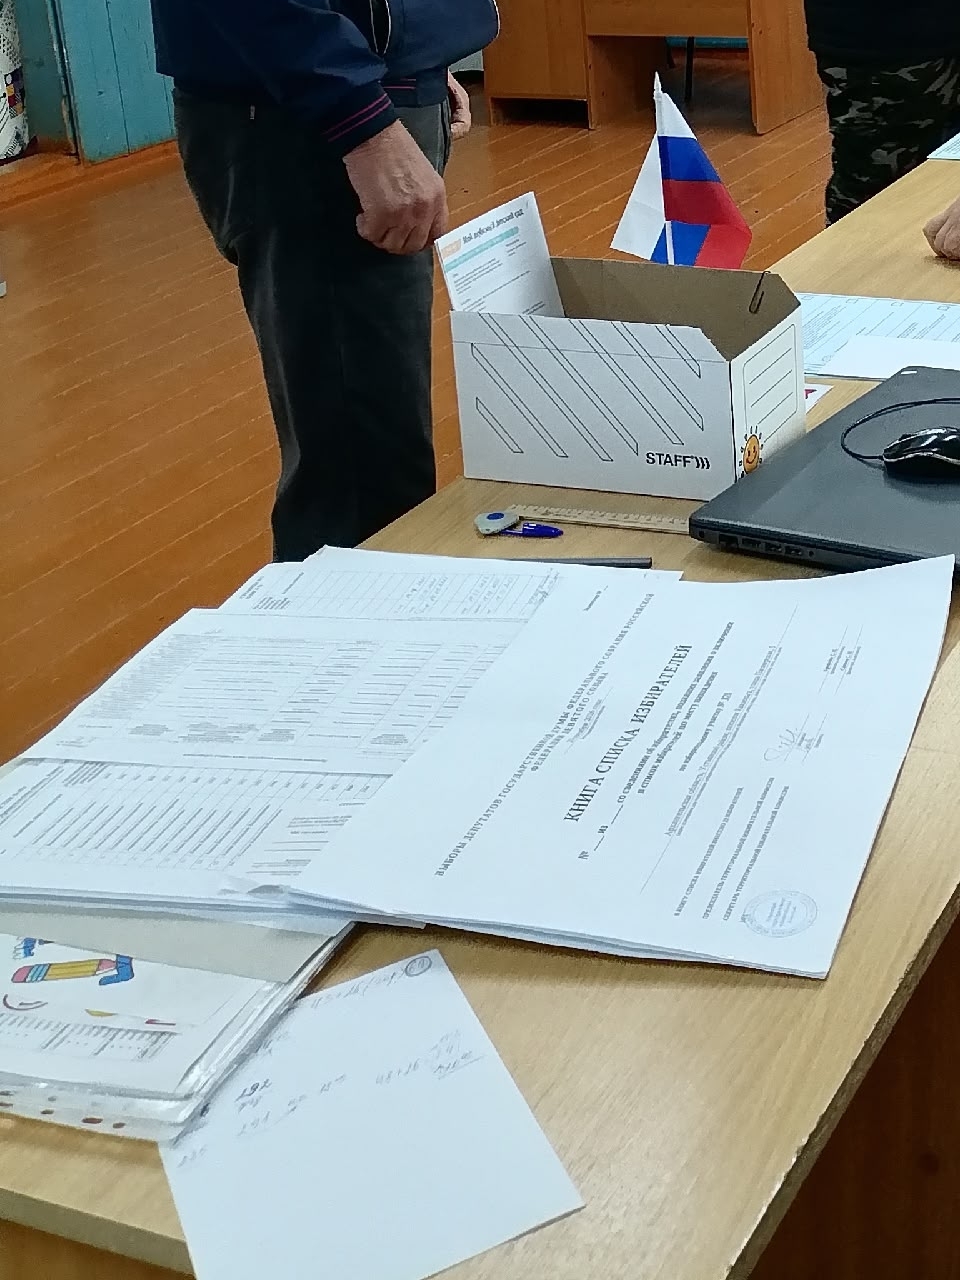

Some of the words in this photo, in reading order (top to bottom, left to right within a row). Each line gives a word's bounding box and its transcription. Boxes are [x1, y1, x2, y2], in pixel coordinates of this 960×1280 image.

[645, 452, 692, 468] STAFF
[432, 841, 469, 876] ВЫБОРЫ
[461, 798, 503, 840] ДЕПУТАТОВ
[494, 733, 555, 797] ГОСУДАРСТВЕННОЙ
[563, 660, 607, 709] ФЕДЕРАЛЬНОГО
[600, 629, 629, 659] СОБРАНИЯ
[622, 592, 655, 628] РОССИЙСКОЙ
[528, 734, 566, 771] ФЕДЕРАЦИИ
[560, 697, 591, 734] ДЕВЯТОГО
[584, 672, 609, 695] СОЗЫВА
[562, 776, 605, 821] КНИГА
[592, 727, 642, 773] СПИСКА
[628, 644, 694, 723] ИЗБИРАТЕЛЕЙ
[721, 892, 741, 921] СЕКРЕТАРЬ
